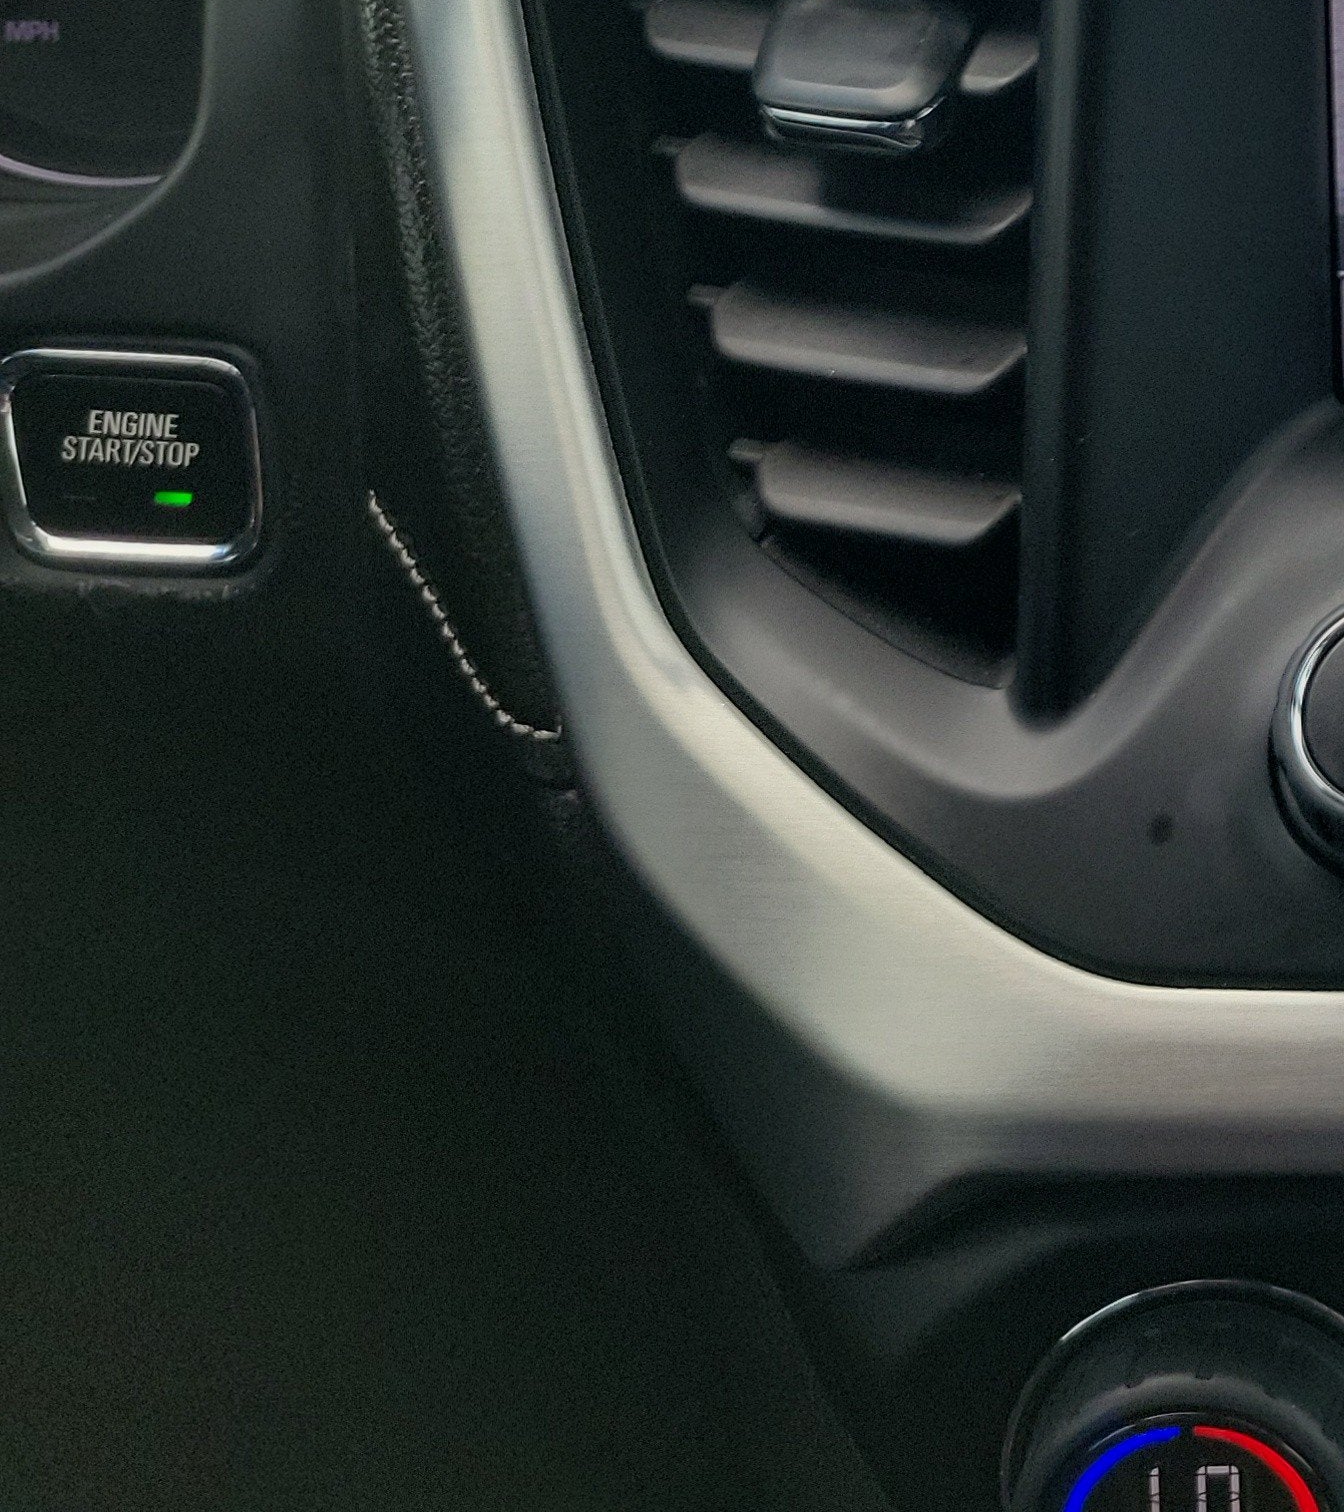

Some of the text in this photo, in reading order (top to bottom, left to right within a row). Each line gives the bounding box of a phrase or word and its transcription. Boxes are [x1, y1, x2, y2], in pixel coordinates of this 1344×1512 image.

[4, 20, 60, 43] MPH
[88, 409, 180, 438] ENGINE
[60, 436, 200, 468] START/STOP
